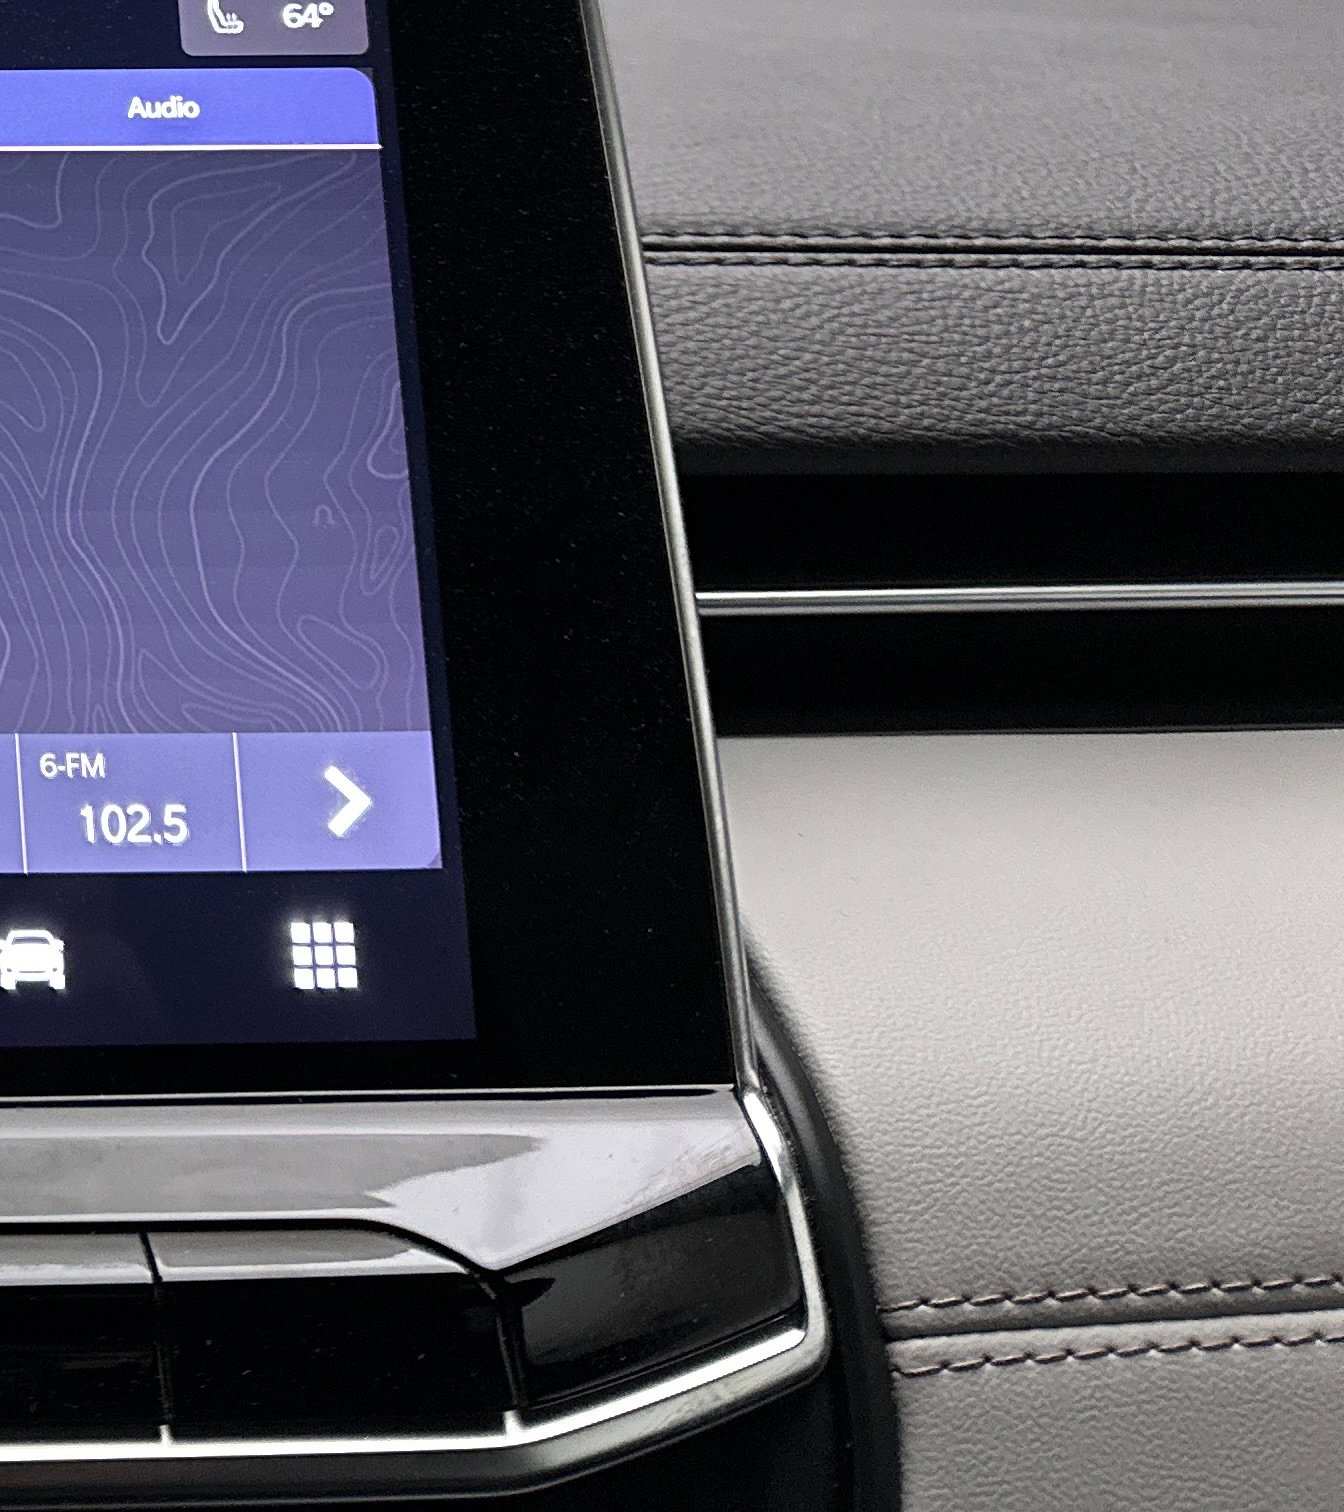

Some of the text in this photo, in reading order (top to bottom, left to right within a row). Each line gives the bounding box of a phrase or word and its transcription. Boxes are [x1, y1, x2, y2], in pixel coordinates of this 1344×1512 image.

[281, 1, 335, 29] 64°
[127, 94, 201, 121] Audio
[39, 750, 106, 780] 6-FM
[80, 802, 191, 847] 102.5
